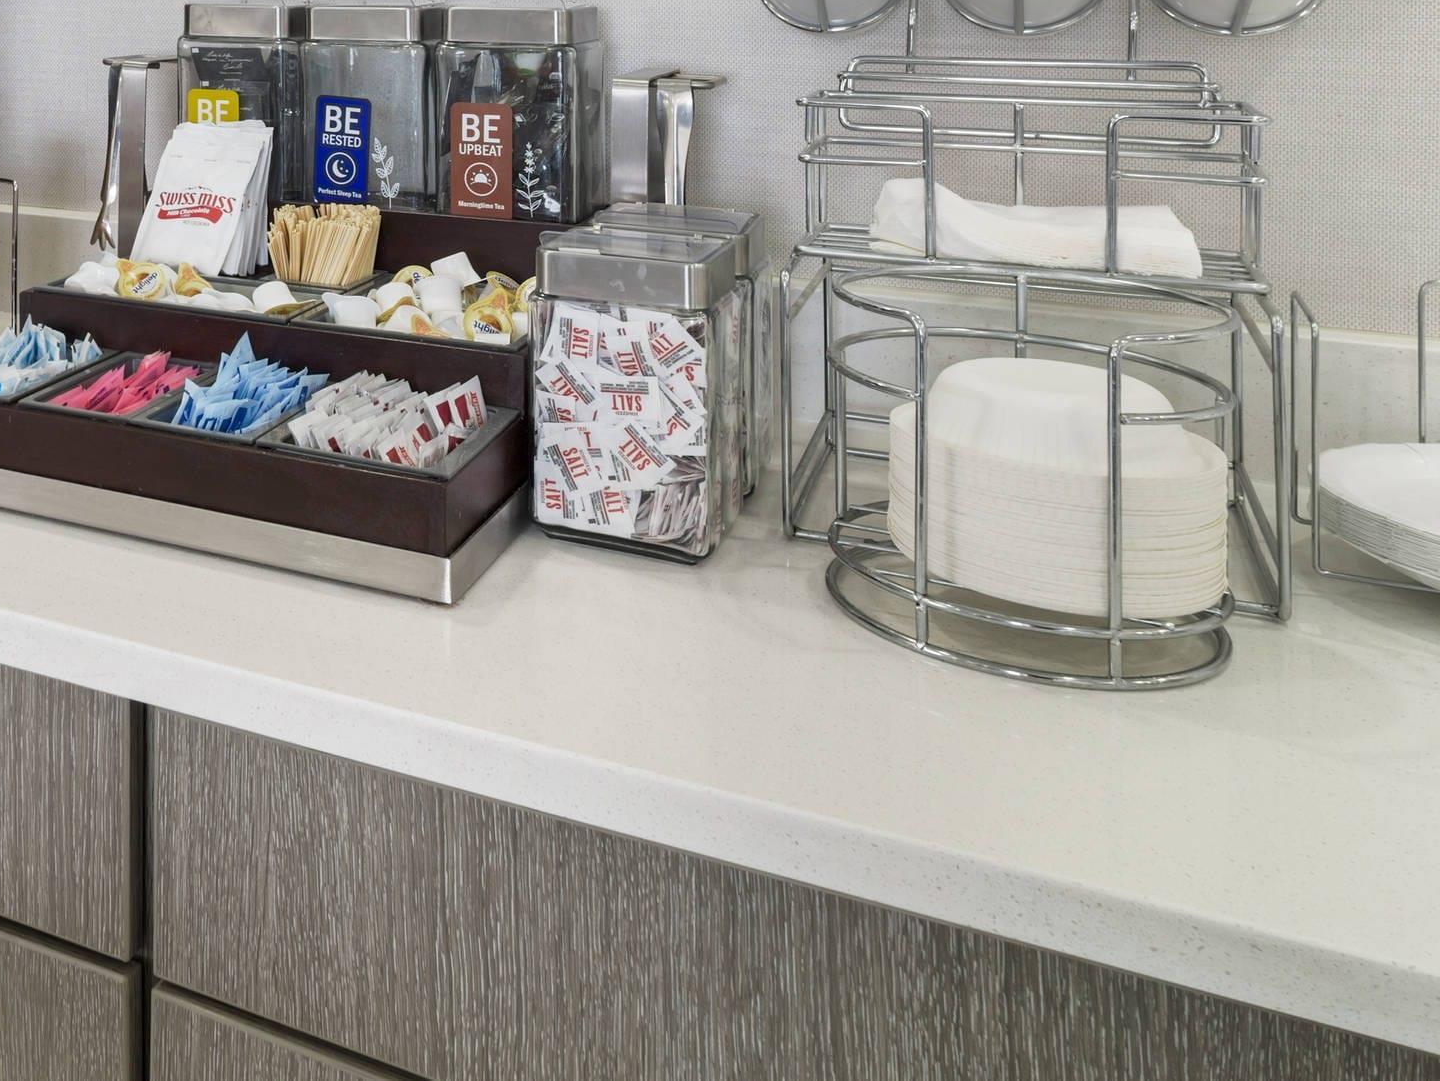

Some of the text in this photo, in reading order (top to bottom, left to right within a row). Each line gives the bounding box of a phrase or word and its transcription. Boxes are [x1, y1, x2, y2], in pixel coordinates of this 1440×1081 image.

[197, 99, 230, 124] BE
[325, 105, 361, 135] BE
[462, 113, 501, 143] BE
[322, 133, 362, 148] RESTED
[459, 143, 503, 157] UPBEAT
[156, 191, 236, 214] SWISS MISS
[318, 187, 336, 195] Perfect
[337, 189, 351, 198] Sleep
[458, 200, 493, 209] Morningtime
[132, 271, 159, 295] delight
[571, 327, 590, 359] SALT
[651, 333, 673, 356] ALT
[612, 394, 642, 412] SALT
[563, 447, 590, 479] SALT
[618, 439, 651, 471] SALT
[544, 478, 562, 510] SALT
